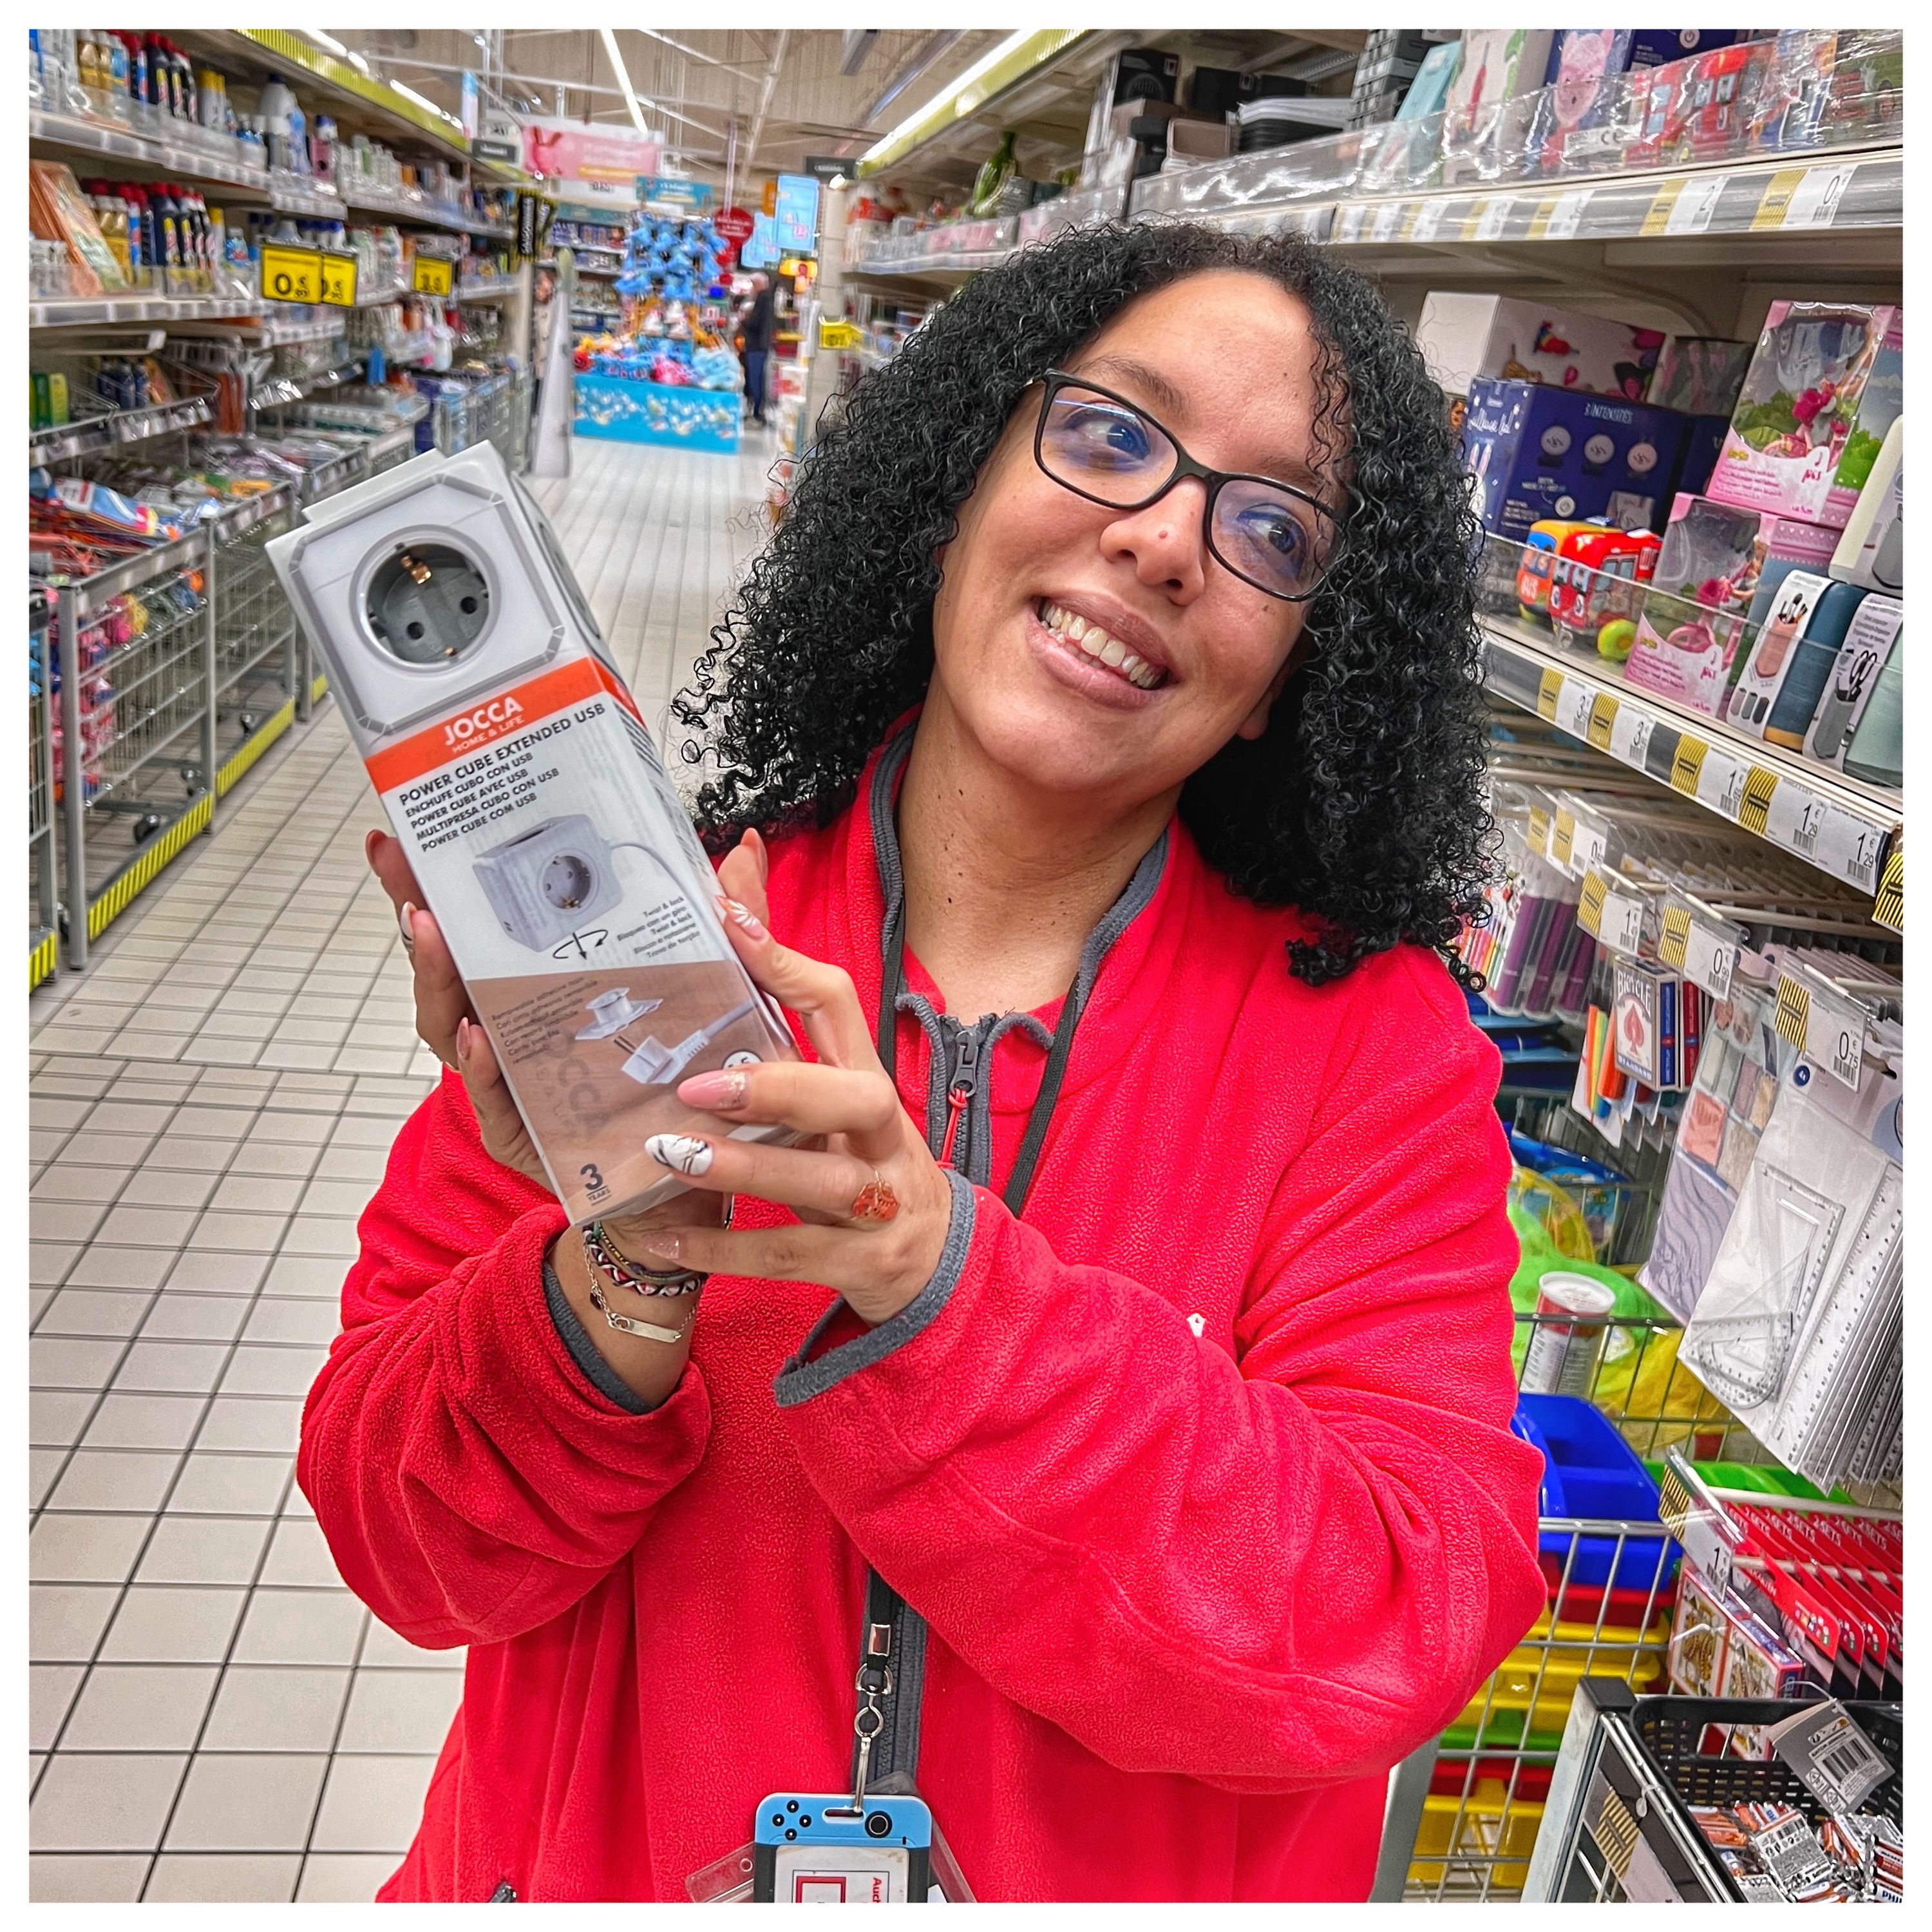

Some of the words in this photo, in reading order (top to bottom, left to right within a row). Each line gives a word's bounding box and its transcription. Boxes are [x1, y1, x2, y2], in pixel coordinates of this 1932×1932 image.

[274, 273, 290, 296] 0
[1577, 696, 1586, 719] 3
[444, 696, 524, 746] JOCCA
[453, 732, 488, 753] HOME
[488, 728, 497, 737] &
[498, 715, 525, 732] LIFE
[1633, 721, 1643, 745] 3
[399, 773, 453, 806] POWER
[455, 754, 494, 779] CUBE
[495, 718, 571, 761] EXTENDED
[574, 703, 605, 723] USB
[405, 789, 453, 818] ENCHUFE
[455, 775, 484, 794] CUBO
[487, 763, 511, 779] CON
[511, 752, 533, 767] USB
[1728, 770, 1737, 797] 1
[411, 806, 449, 829] POWER
[451, 793, 478, 811] CUBE
[479, 779, 506, 799] AVEC
[507, 769, 529, 784] USB
[417, 806, 480, 841] MULTIPRESA
[481, 791, 510, 810] CUBO
[513, 779, 536, 795] CON
[538, 768, 560, 782] USB
[422, 829, 460, 852] POWER
[461, 816, 488, 833] CUBE
[489, 804, 515, 820] COM
[515, 793, 537, 808] USB
[1803, 803, 1812, 831] 1
[1808, 822, 1818, 838] 29
[1857, 832, 1866, 862] 1
[1870, 838, 1875, 849] €
[1864, 853, 1874, 868] 29
[1626, 909, 1631, 934] 1
[1714, 948, 1722, 974] 0
[1618, 970, 1651, 1019] BICYCLE
[1839, 1031, 1849, 1060] 0
[1853, 1039, 1857, 1050] €
[1618, 1055, 1652, 1081] STANDARD
[1850, 1052, 1859, 1069] 75
[580, 1164, 603, 1190] 3
[1820, 1520, 1841, 1546] SETS
[1866, 1523, 1887, 1549] SETS
[1714, 1547, 1720, 1571] 1
